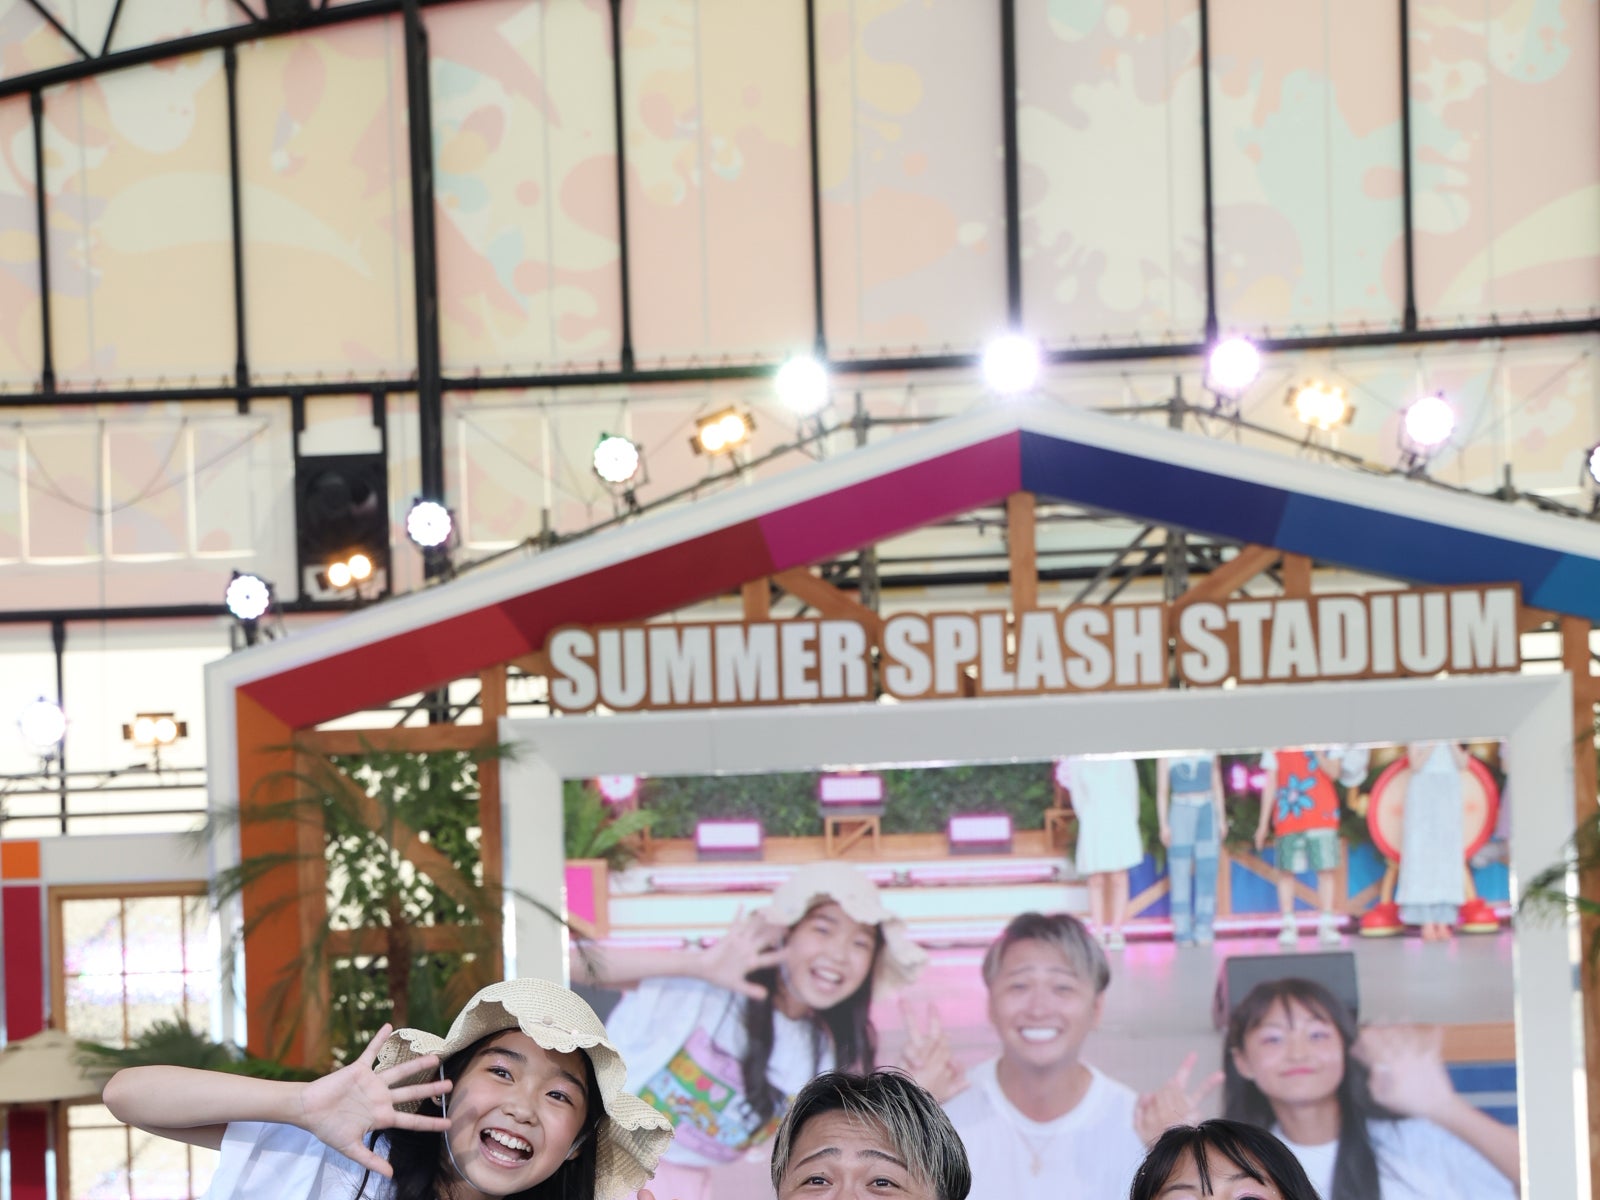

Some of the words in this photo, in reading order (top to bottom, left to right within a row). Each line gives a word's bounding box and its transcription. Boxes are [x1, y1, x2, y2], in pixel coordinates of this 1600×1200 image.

[550, 620, 867, 709] SUMMER
[884, 606, 1164, 696] SPLASH
[1180, 588, 1517, 683] STADIUM
